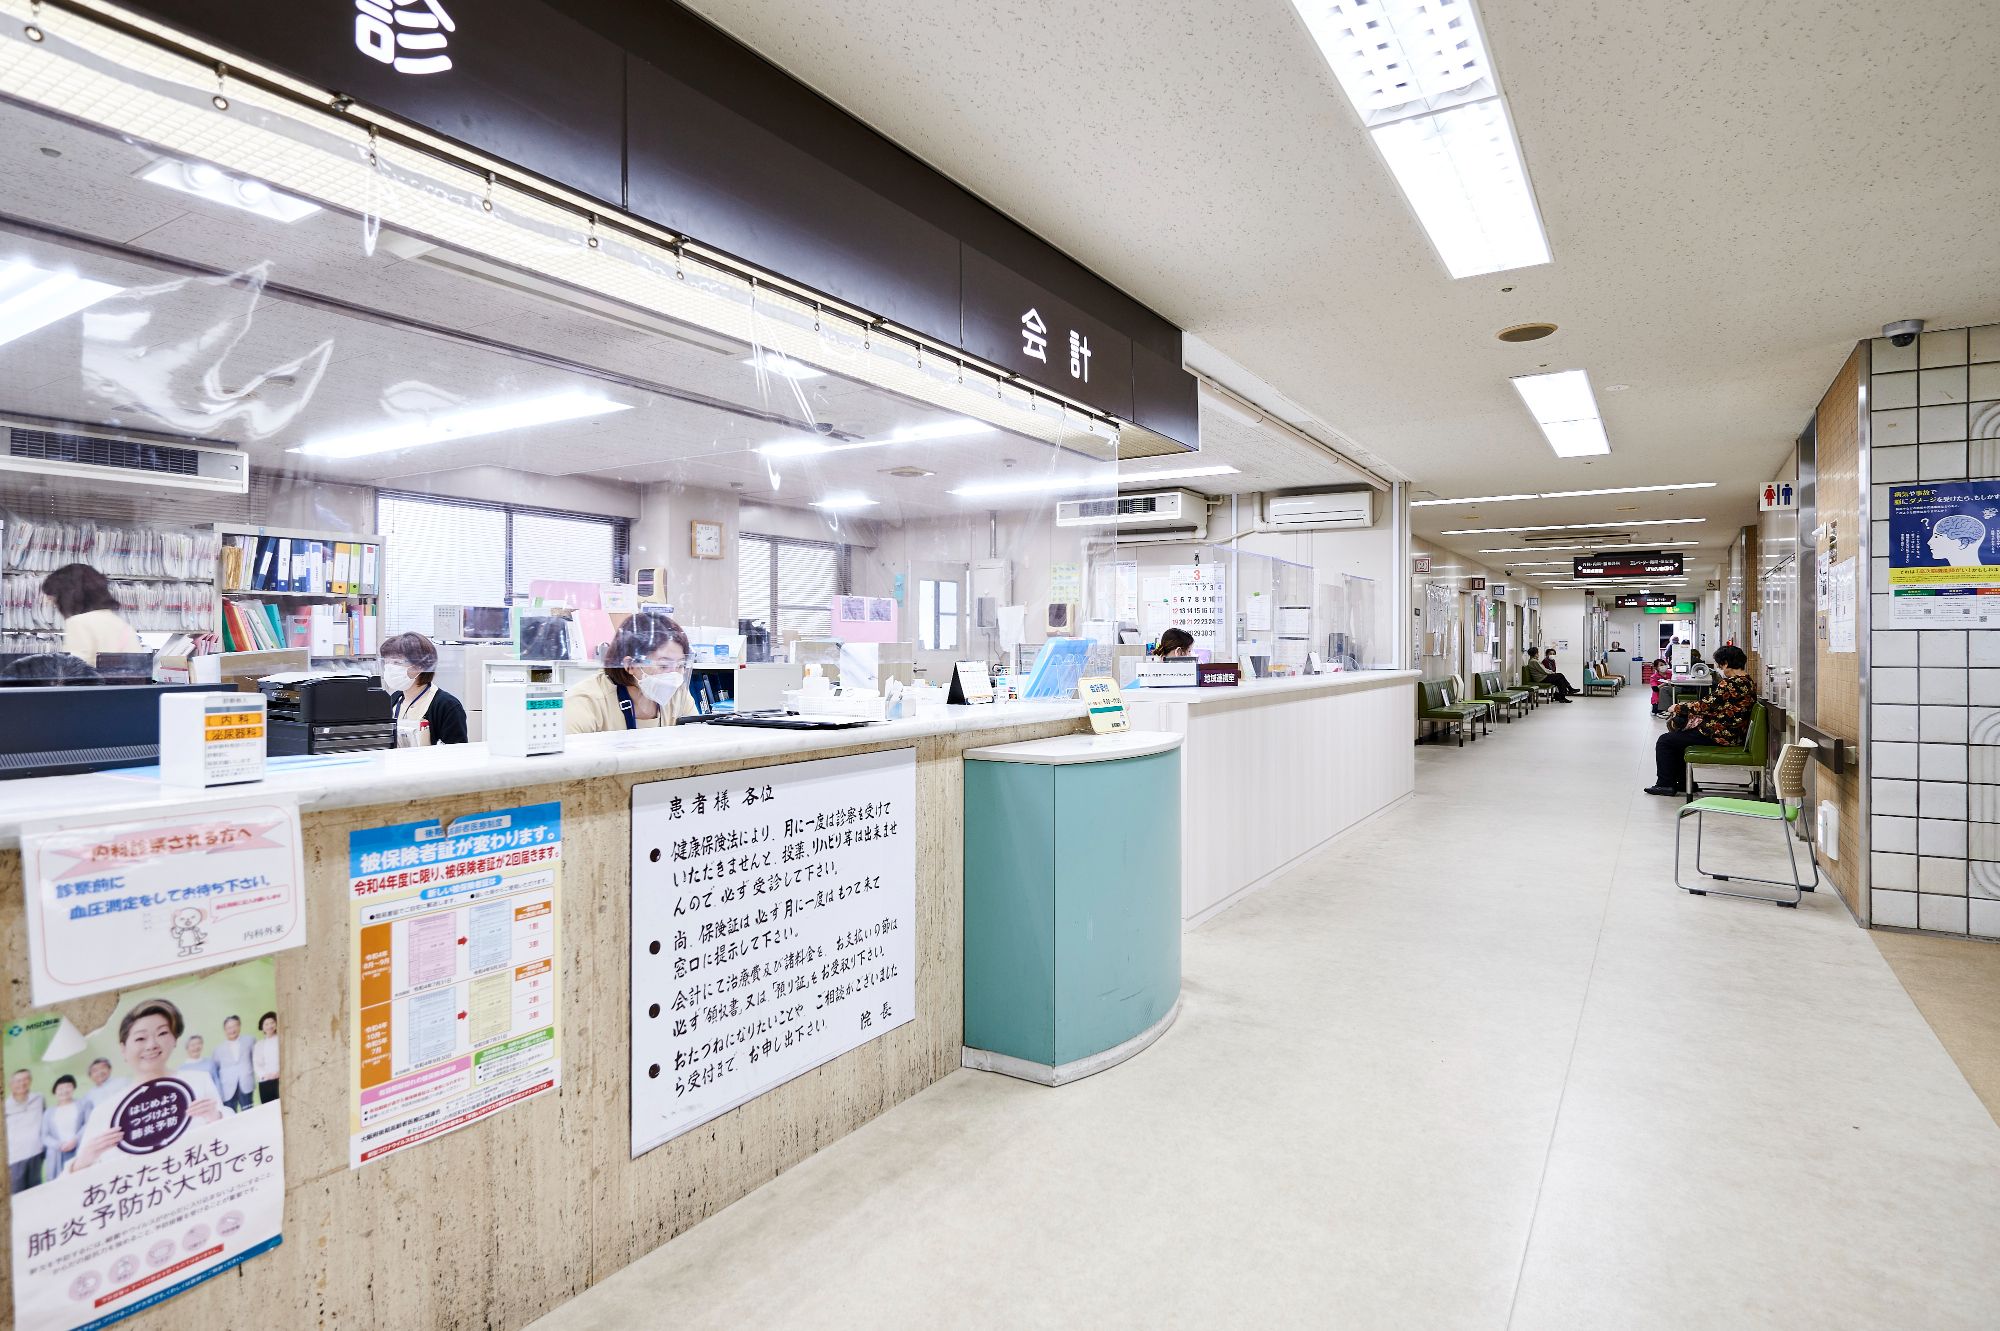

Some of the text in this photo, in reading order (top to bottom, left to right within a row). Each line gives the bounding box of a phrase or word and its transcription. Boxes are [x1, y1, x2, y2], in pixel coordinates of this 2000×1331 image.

[1022, 308, 1092, 383] 会計
[211, 727, 257, 741] 泌尿器科
[221, 715, 249, 726] 内科
[668, 784, 775, 821] 患者様 各位
[91, 827, 253, 862] 内科診察される方へ
[360, 825, 556, 873] 被保険者証が変わります。
[56, 876, 125, 899] 診察前に
[354, 846, 559, 896] 令和4年度に限り、被保険者証が2回届きます。
[69, 875, 270, 920] 血圧測定をしてお待ち下さい。
[243, 924, 284, 941] 内科外来
[674, 927, 799, 980] 窓口に提示して下さい。
[860, 1002, 893, 1031] 院長
[129, 1094, 177, 1116] はじめよう
[130, 1106, 178, 1127] つづけよう
[131, 1118, 178, 1140] 肺炎予防
[82, 1138, 230, 1208] あなたも私も
[28, 1146, 274, 1258] 肺炎予防が大切です。
